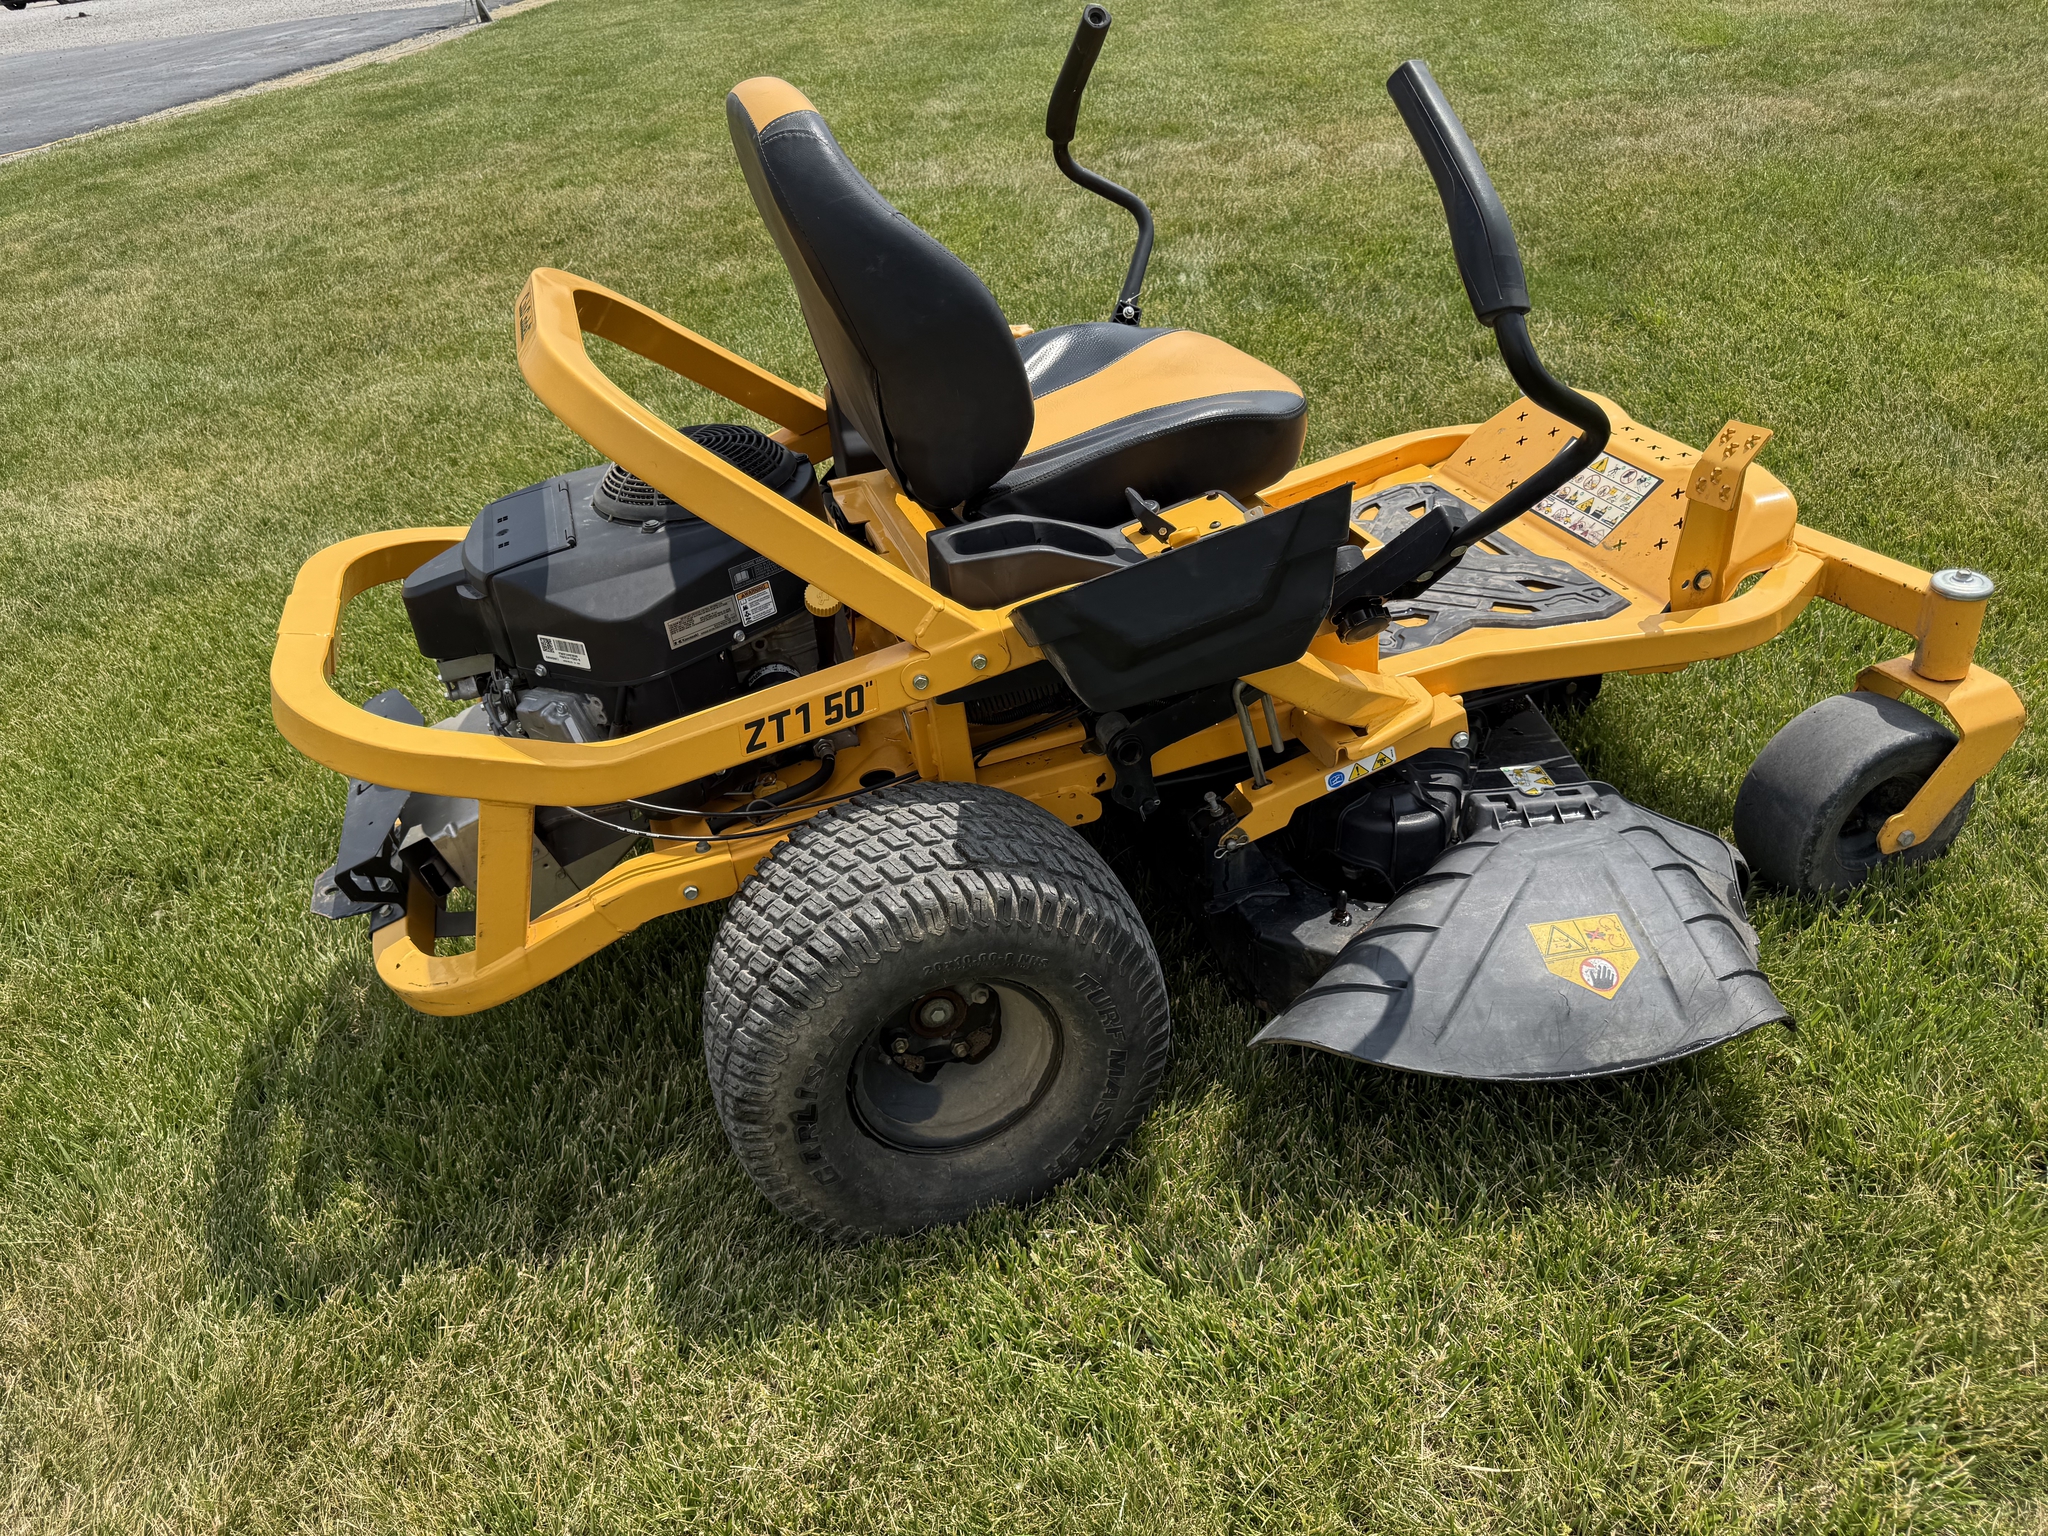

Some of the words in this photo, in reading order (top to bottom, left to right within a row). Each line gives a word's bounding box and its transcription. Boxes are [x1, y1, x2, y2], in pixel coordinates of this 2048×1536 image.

[743, 584, 765, 598] WARNING
[744, 702, 811, 754] ZT1
[824, 681, 873, 726] 50"
[1072, 971, 1128, 1043] TURF
[792, 1016, 856, 1186] CARLISLE
[1042, 1048, 1129, 1180] MASTER
